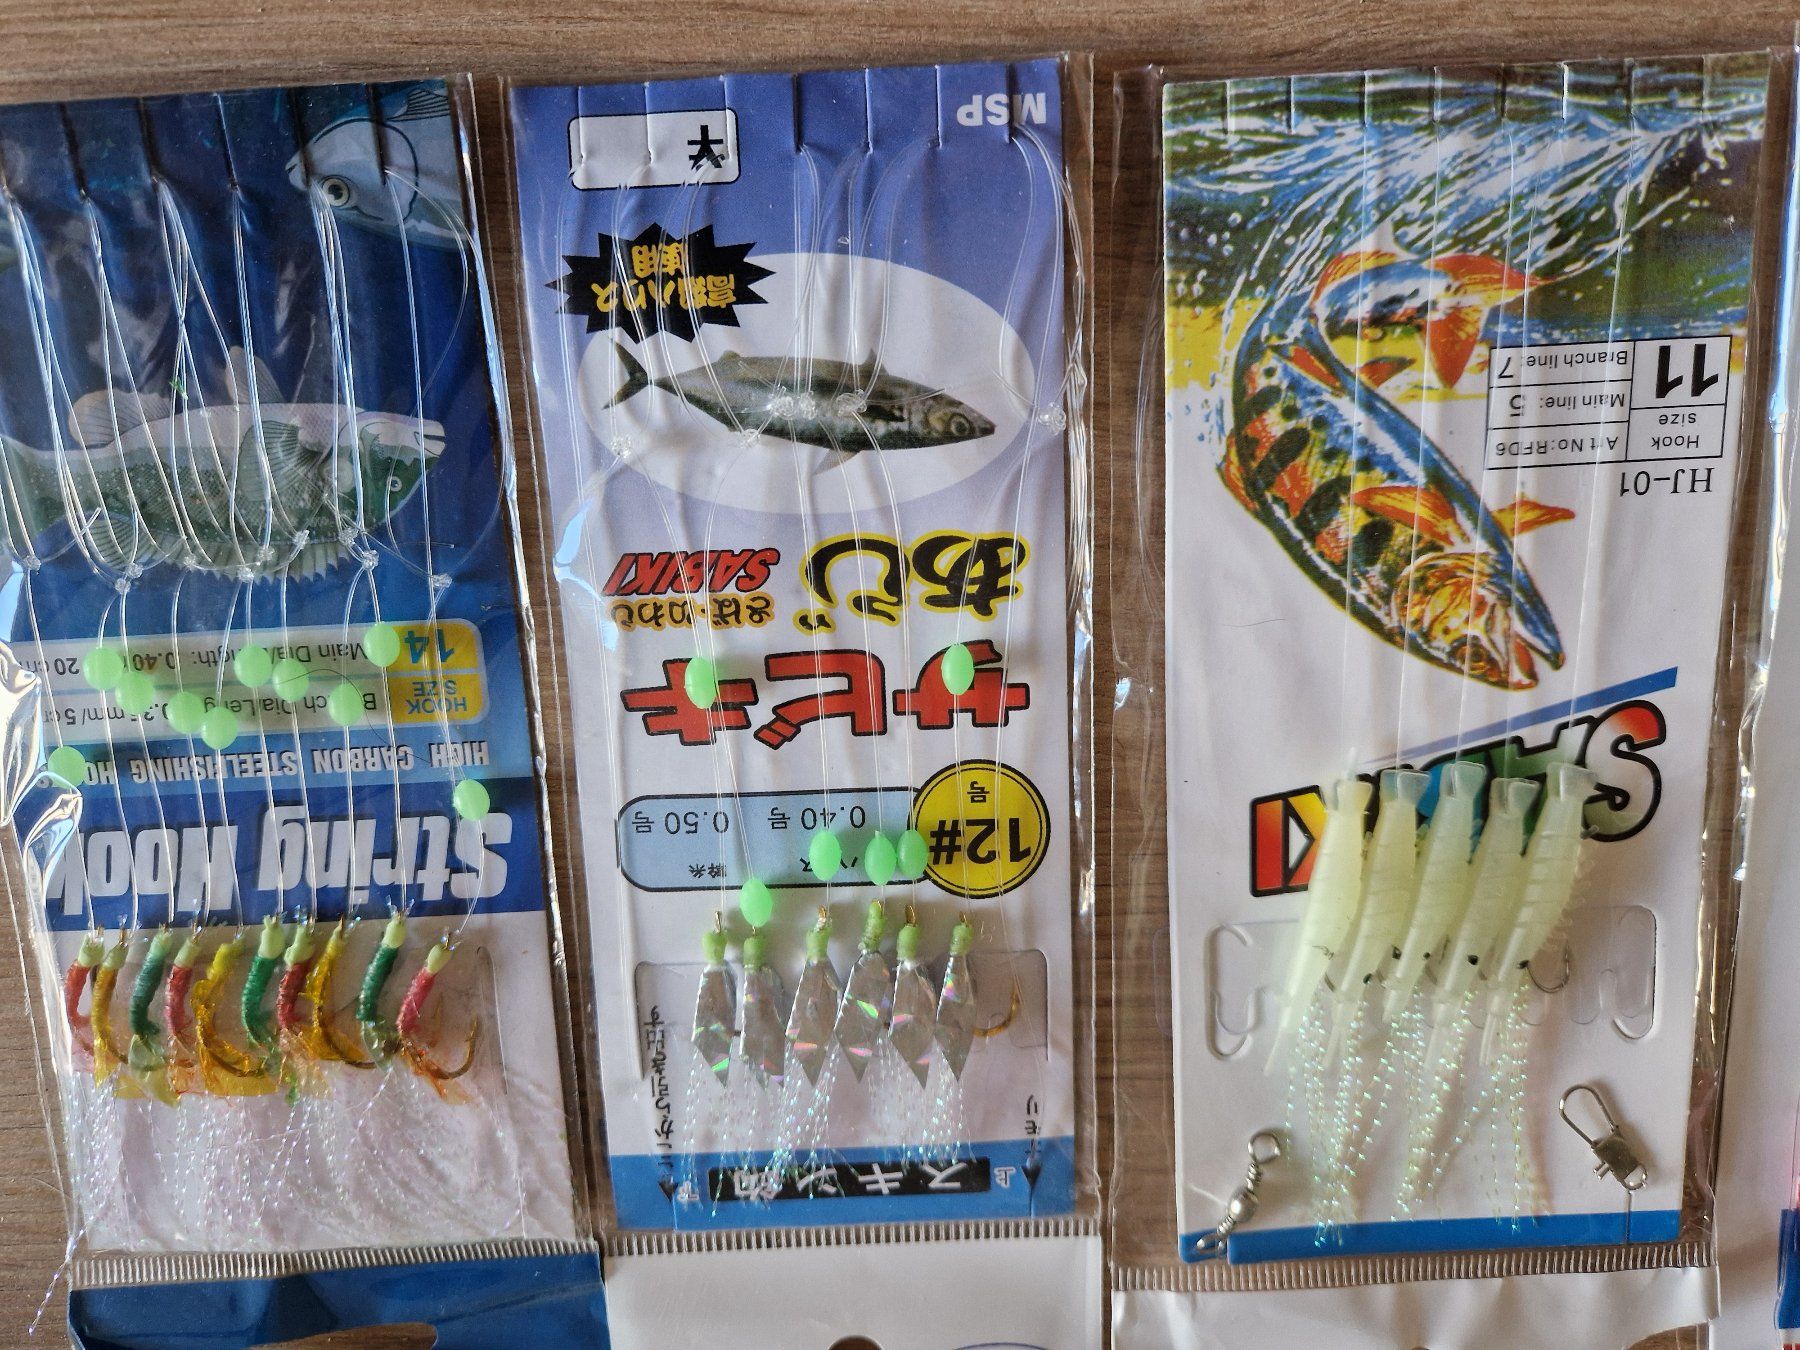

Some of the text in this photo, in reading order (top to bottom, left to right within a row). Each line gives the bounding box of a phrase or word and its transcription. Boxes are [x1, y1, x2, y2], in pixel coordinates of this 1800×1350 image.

[956, 92, 1048, 127] MSP
[1497, 357, 1514, 378] 7
[1564, 351, 1627, 367] Branch
[1655, 343, 1719, 399] 11
[1509, 393, 1625, 417] Main line: 5
[1658, 412, 1697, 427] size
[1590, 436, 1618, 452] At
[1651, 434, 1699, 450] Hook
[1619, 467, 1715, 496] HJ-01
[600, 548, 780, 596] SABIKI
[794, 532, 1029, 633] あじ
[404, 629, 454, 664] 14
[413, 680, 456, 696] SIZE
[620, 640, 1030, 750] サビキ
[406, 697, 467, 714] HOOK
[312, 745, 414, 774] CARBON
[430, 741, 489, 768] HIGH
[966, 781, 991, 804] 号
[664, 810, 729, 835] 0.50
[800, 805, 866, 831] 0.40
[928, 817, 1032, 865] 12#
[46, 804, 512, 916] String Hook
[799, 856, 858, 873] ハス
